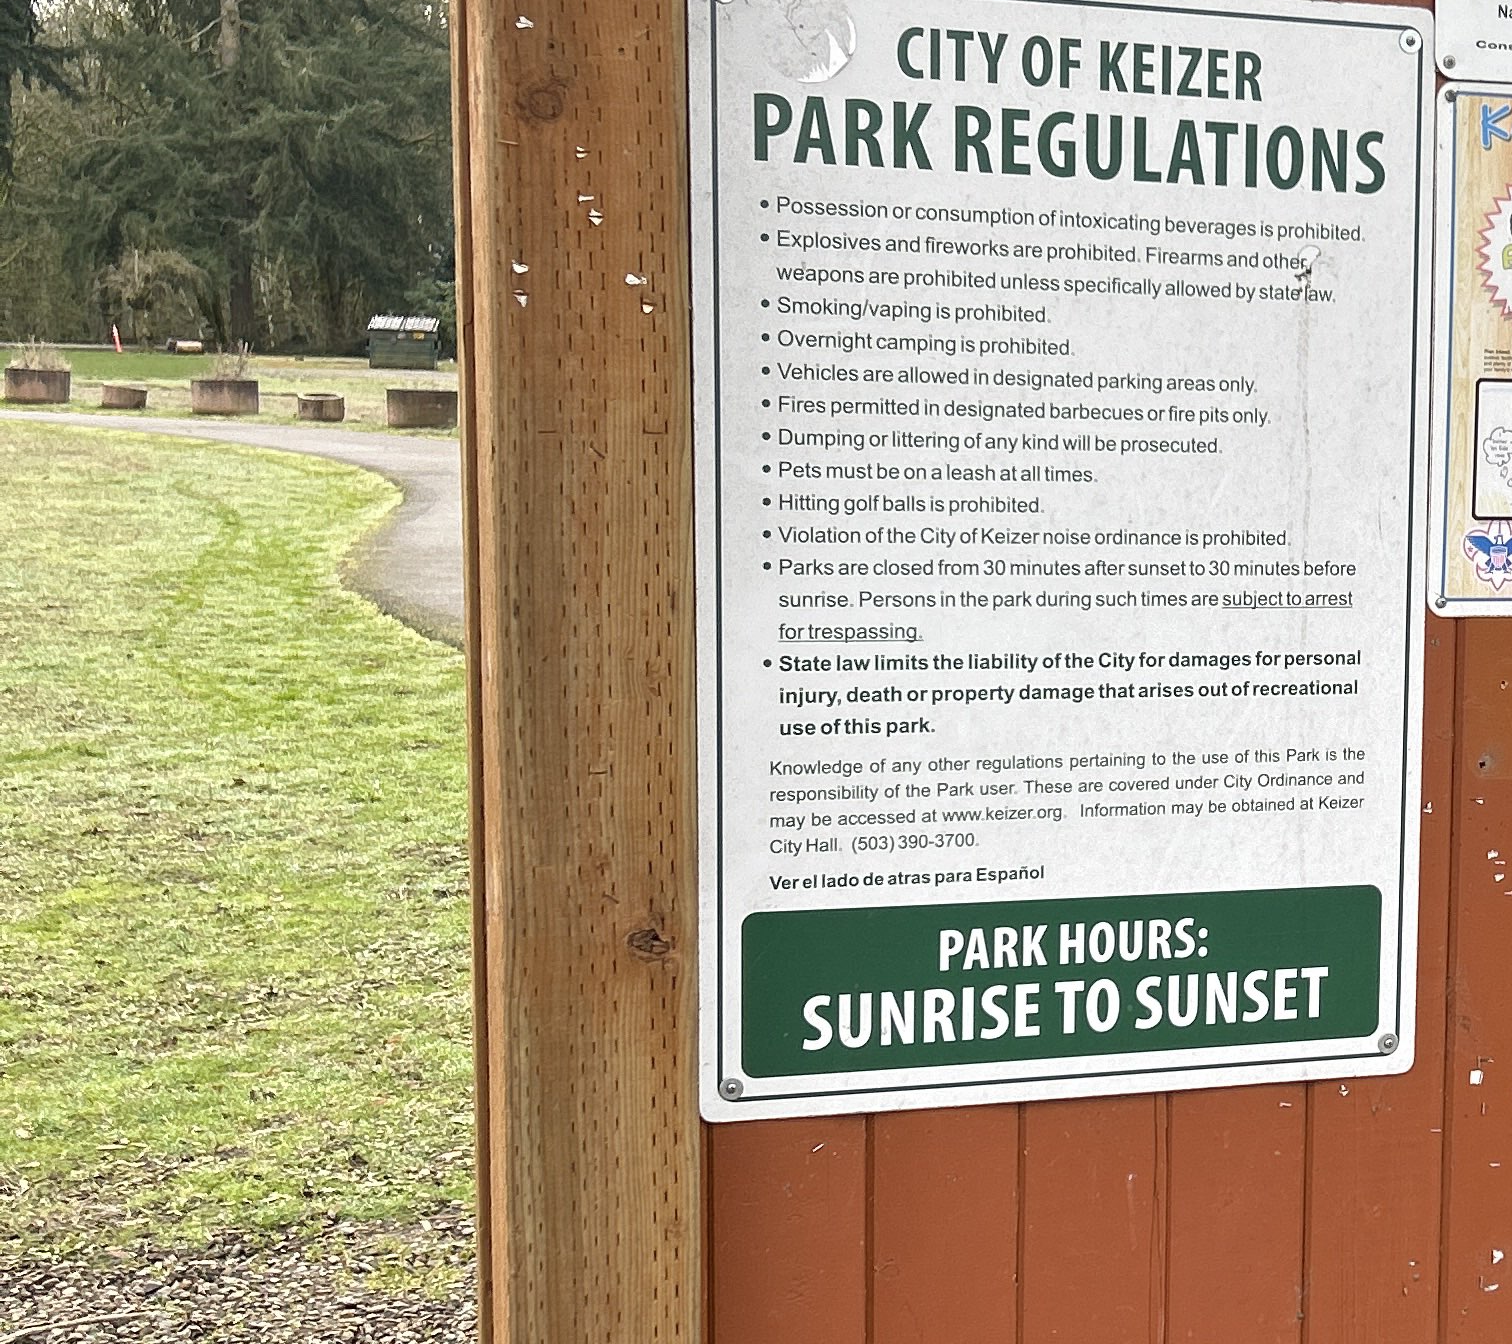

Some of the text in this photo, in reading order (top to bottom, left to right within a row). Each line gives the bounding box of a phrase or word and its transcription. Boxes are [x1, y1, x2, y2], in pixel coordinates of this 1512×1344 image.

[897, 27, 1261, 101] CITY OF KEIZER
[753, 93, 1385, 194] PARK REGULATIONS
[777, 196, 1364, 241] Possession or consumption of intoxicating beverages is prohibited.
[770, 833, 978, 856] City Hall. (503) 390-3700.
[769, 865, 1043, 889] Ver el lado de atras para Español
[940, 917, 1207, 970] PARK HOURS:
[803, 966, 1328, 1050] SUNRISE TO SUNSET
